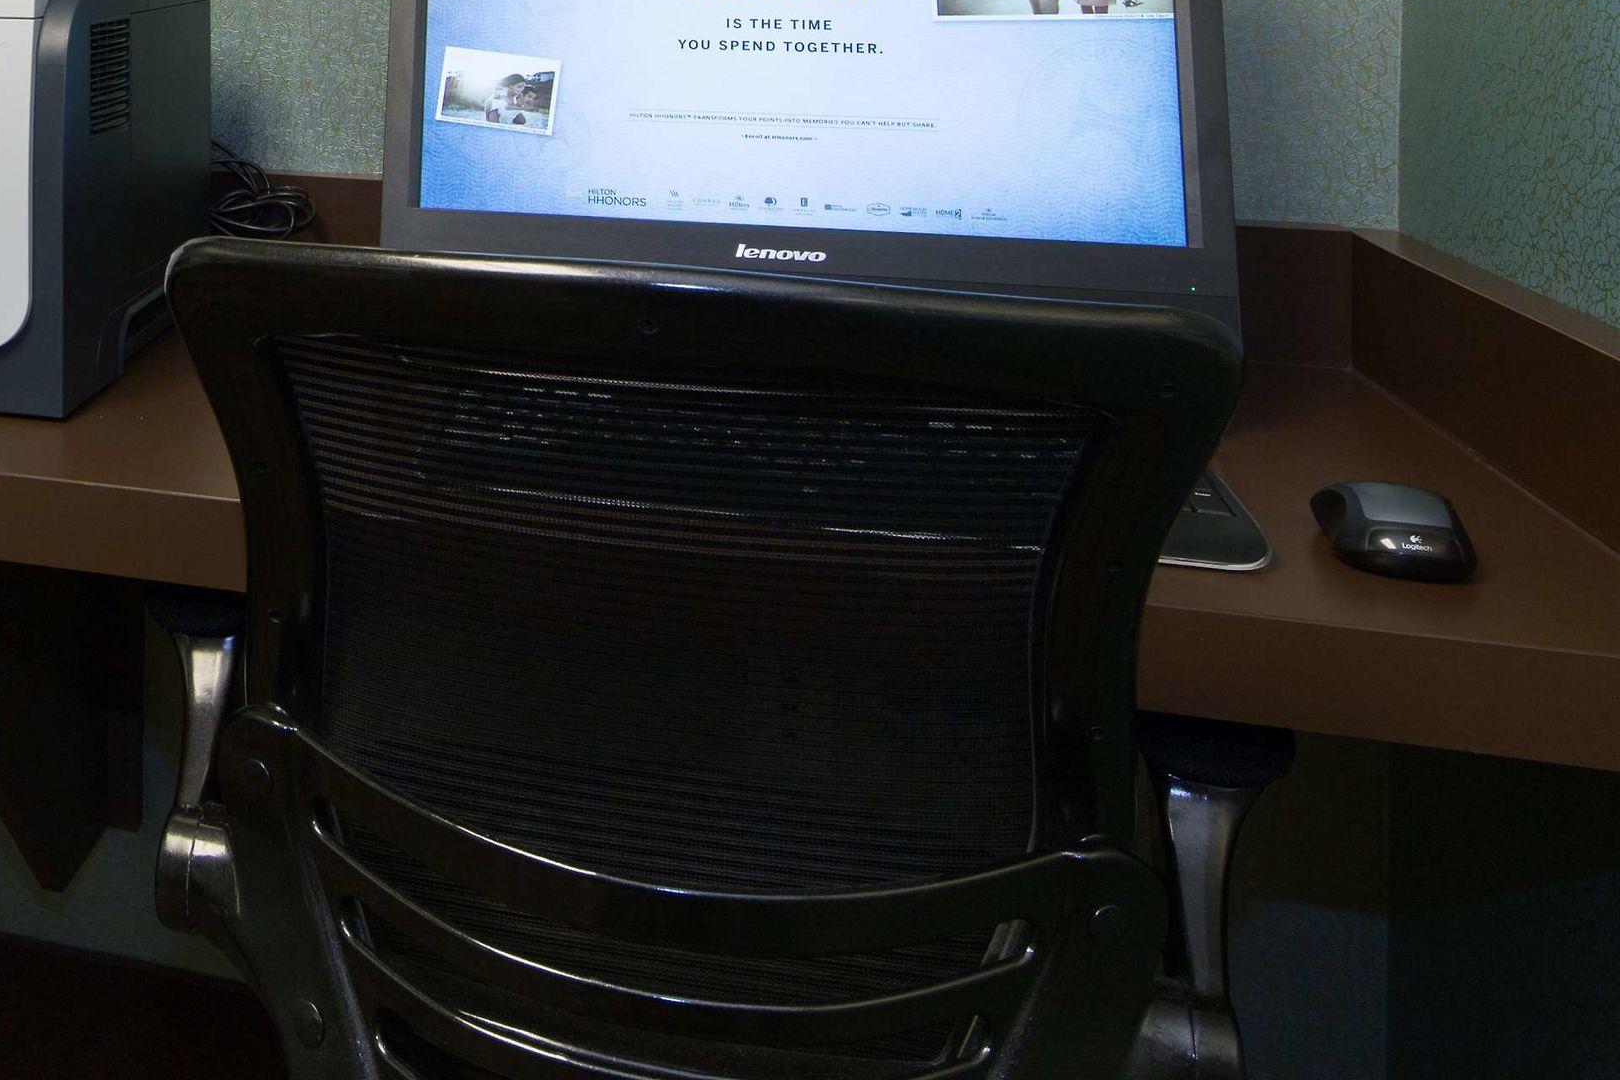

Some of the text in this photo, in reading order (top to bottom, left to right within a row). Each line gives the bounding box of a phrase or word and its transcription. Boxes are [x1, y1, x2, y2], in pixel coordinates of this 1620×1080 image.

[726, 18, 832, 30] IS THE TIME
[678, 39, 884, 54] YOU SPEND TOGETHER.
[588, 188, 617, 196] HILTON
[588, 195, 647, 207] HHONORS
[735, 243, 827, 262] lenovo
[1401, 542, 1433, 552] Logitech
